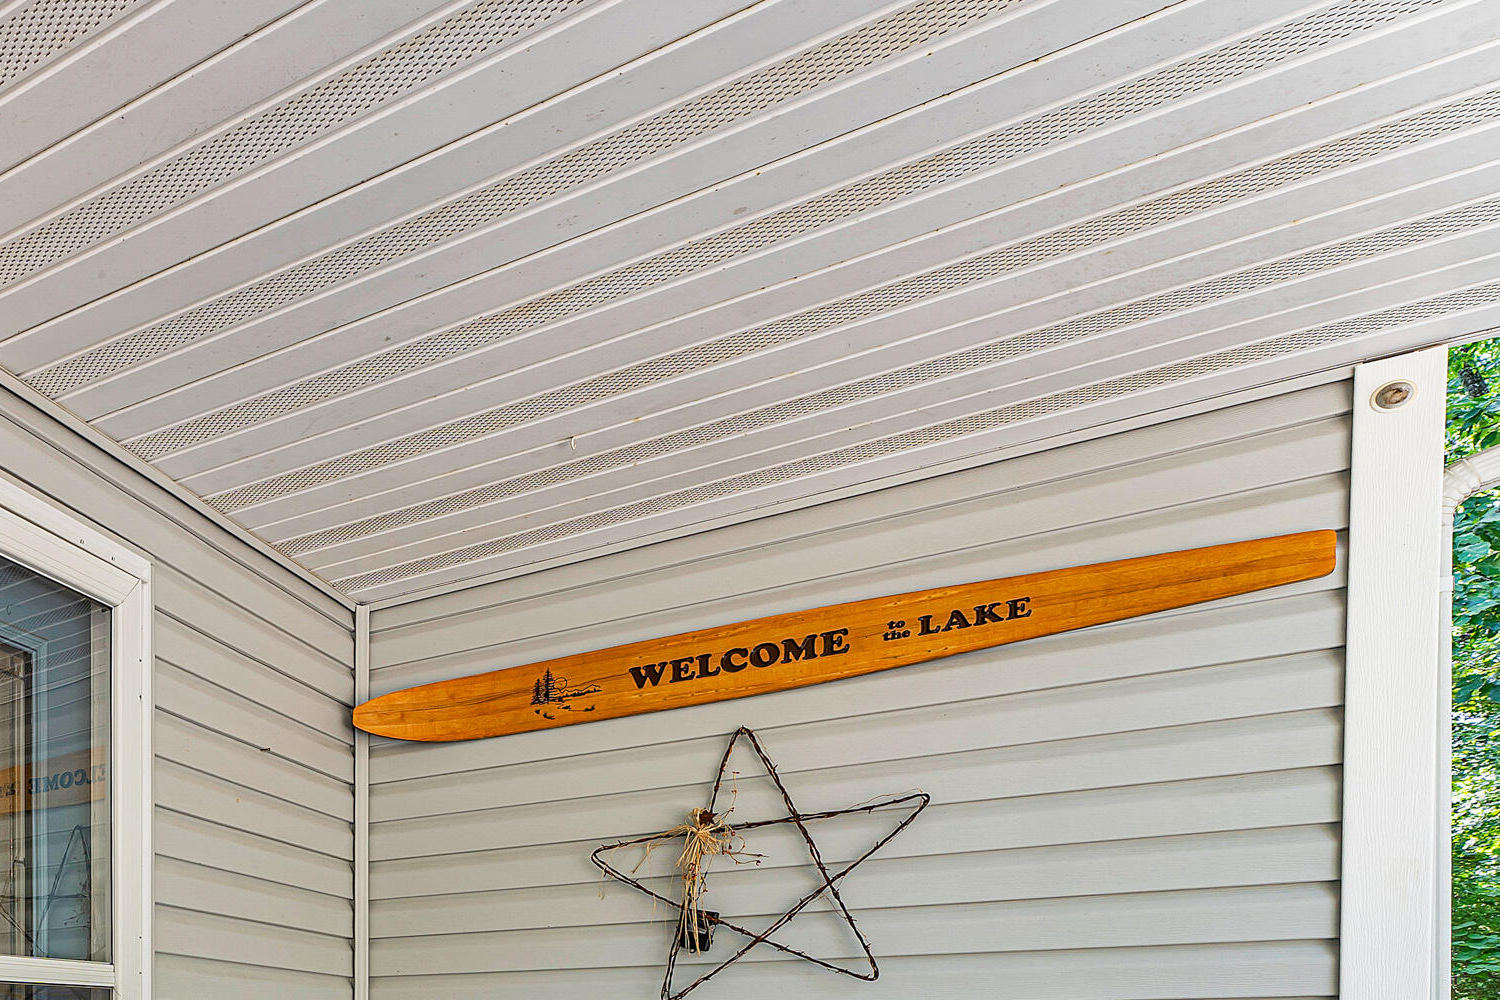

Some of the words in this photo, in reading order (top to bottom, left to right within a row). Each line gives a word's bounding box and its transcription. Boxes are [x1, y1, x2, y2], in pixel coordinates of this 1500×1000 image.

[887, 620, 906, 630] to
[917, 596, 1033, 636] LAKE
[882, 629, 911, 641] the
[628, 628, 851, 689] WELCOME
